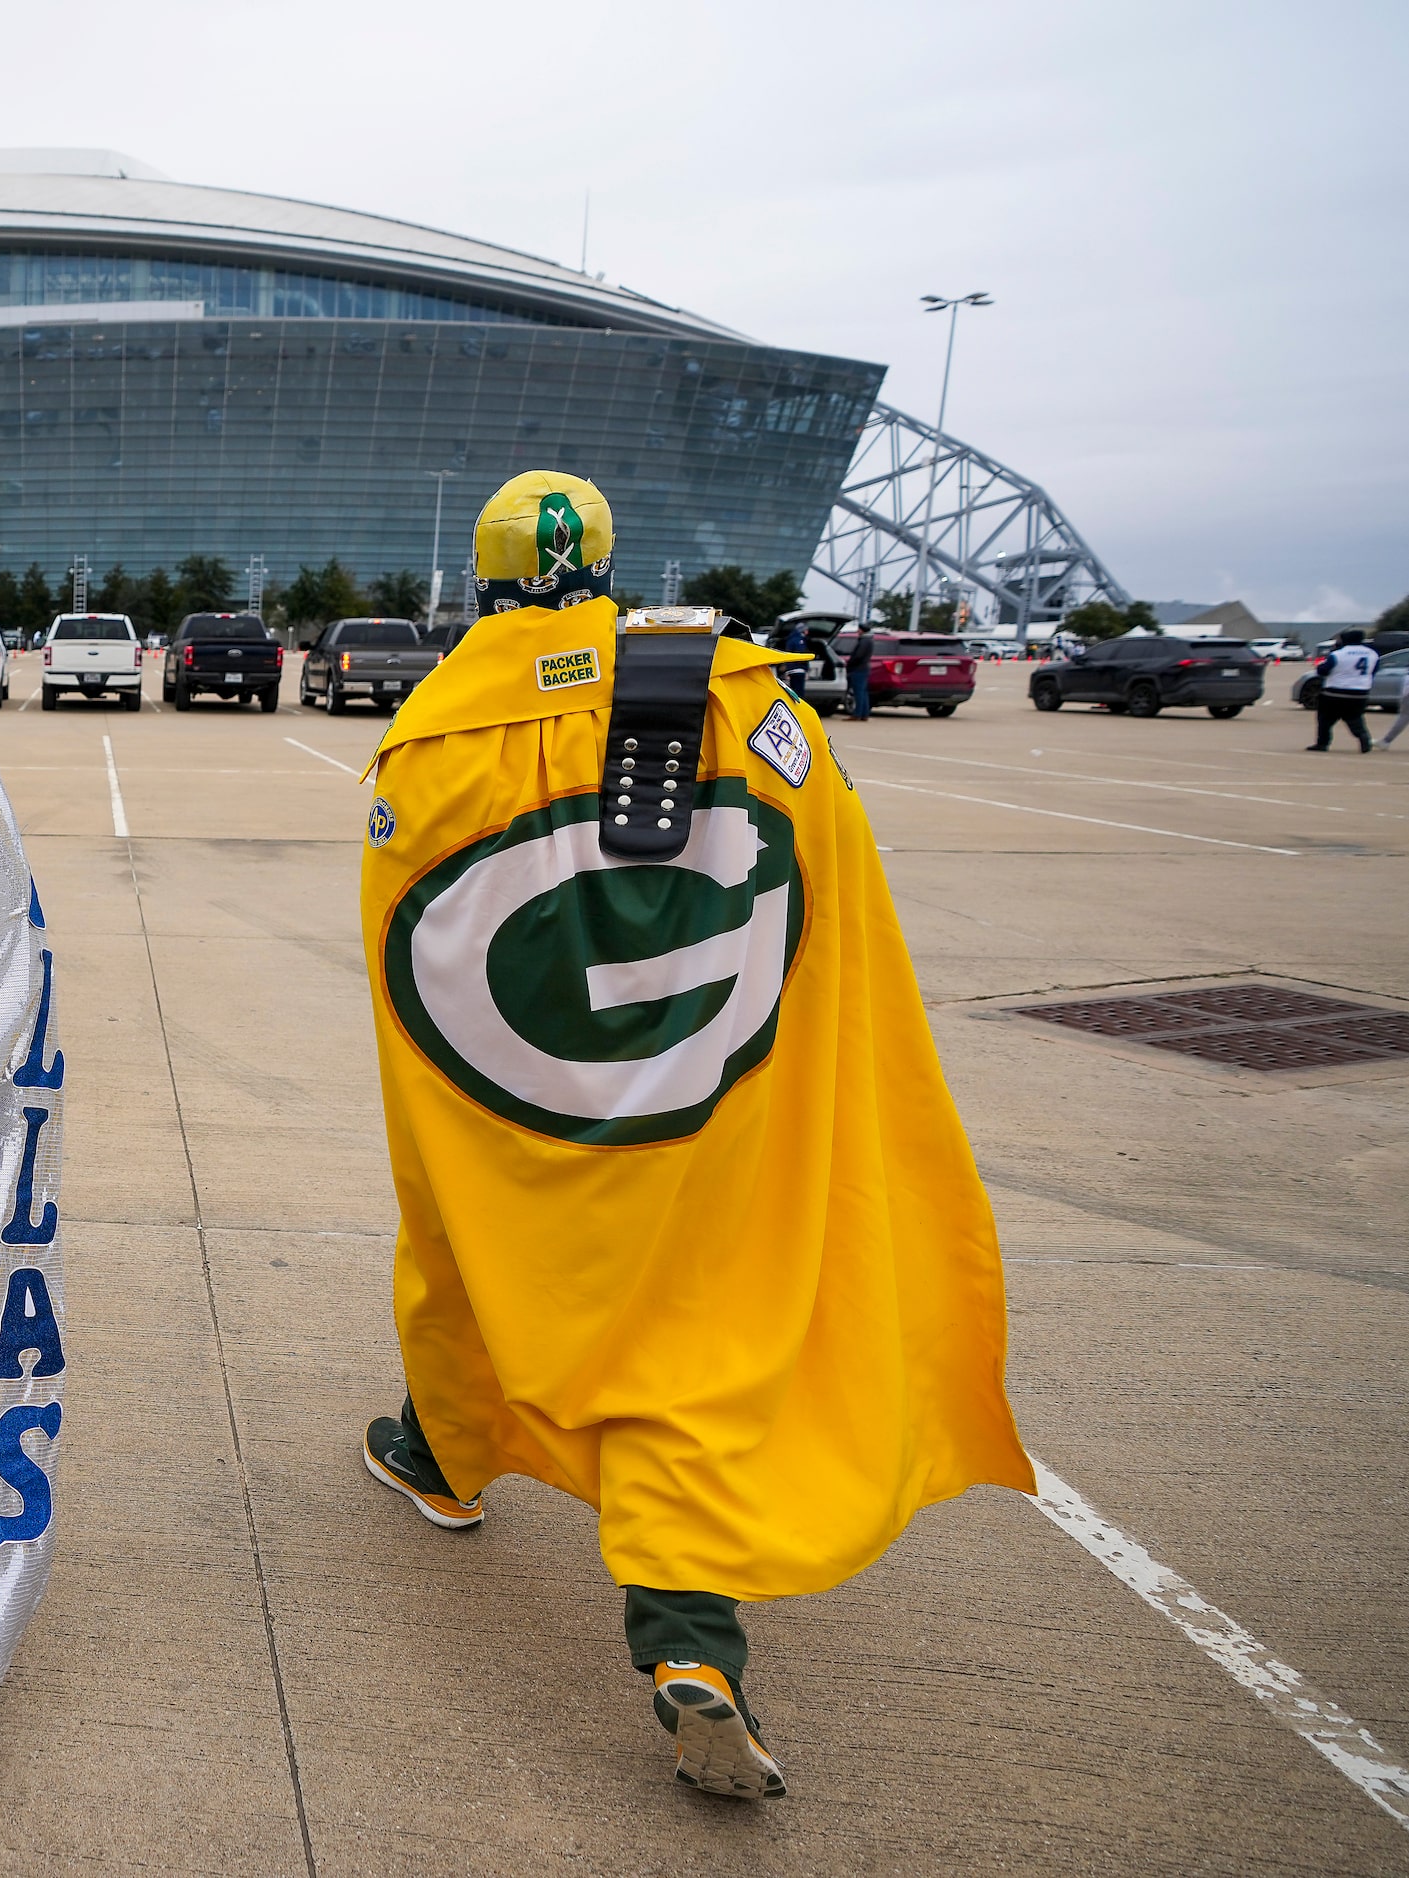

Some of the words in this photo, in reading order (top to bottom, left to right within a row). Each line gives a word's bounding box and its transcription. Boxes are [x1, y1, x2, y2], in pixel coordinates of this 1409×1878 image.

[541, 652, 592, 672] PACKER
[1354, 657, 1369, 676] 4
[543, 667, 594, 686] BACKER
[765, 720, 793, 757] AP
[371, 806, 387, 839] AP
[411, 806, 789, 1120] G
